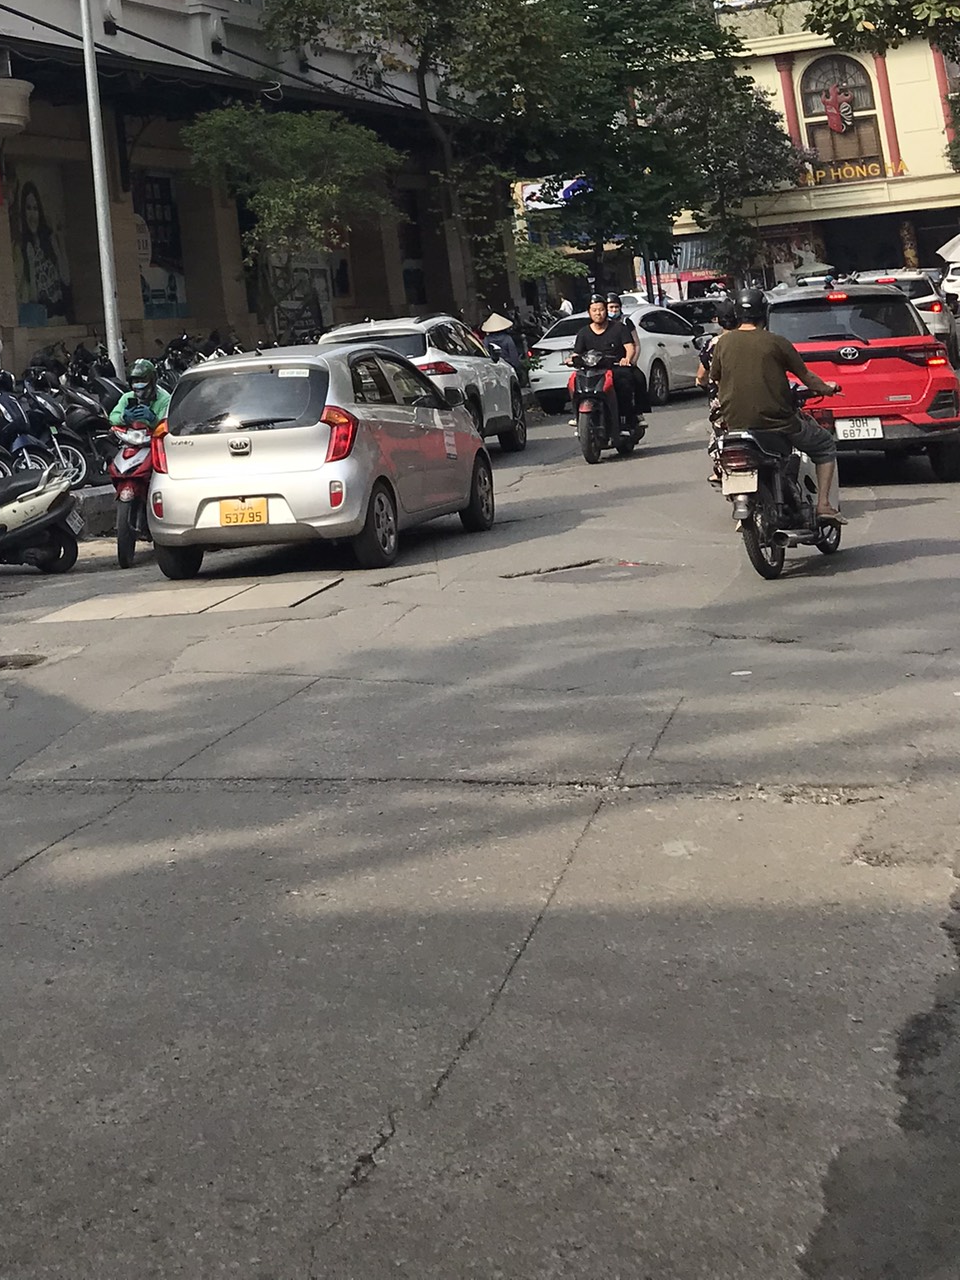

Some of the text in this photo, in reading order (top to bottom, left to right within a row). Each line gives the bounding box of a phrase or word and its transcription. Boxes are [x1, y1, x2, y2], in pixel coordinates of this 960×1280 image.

[849, 418, 868, 428] 30H
[842, 428, 877, 438] 687.17
[225, 511, 262, 524] 537.95
